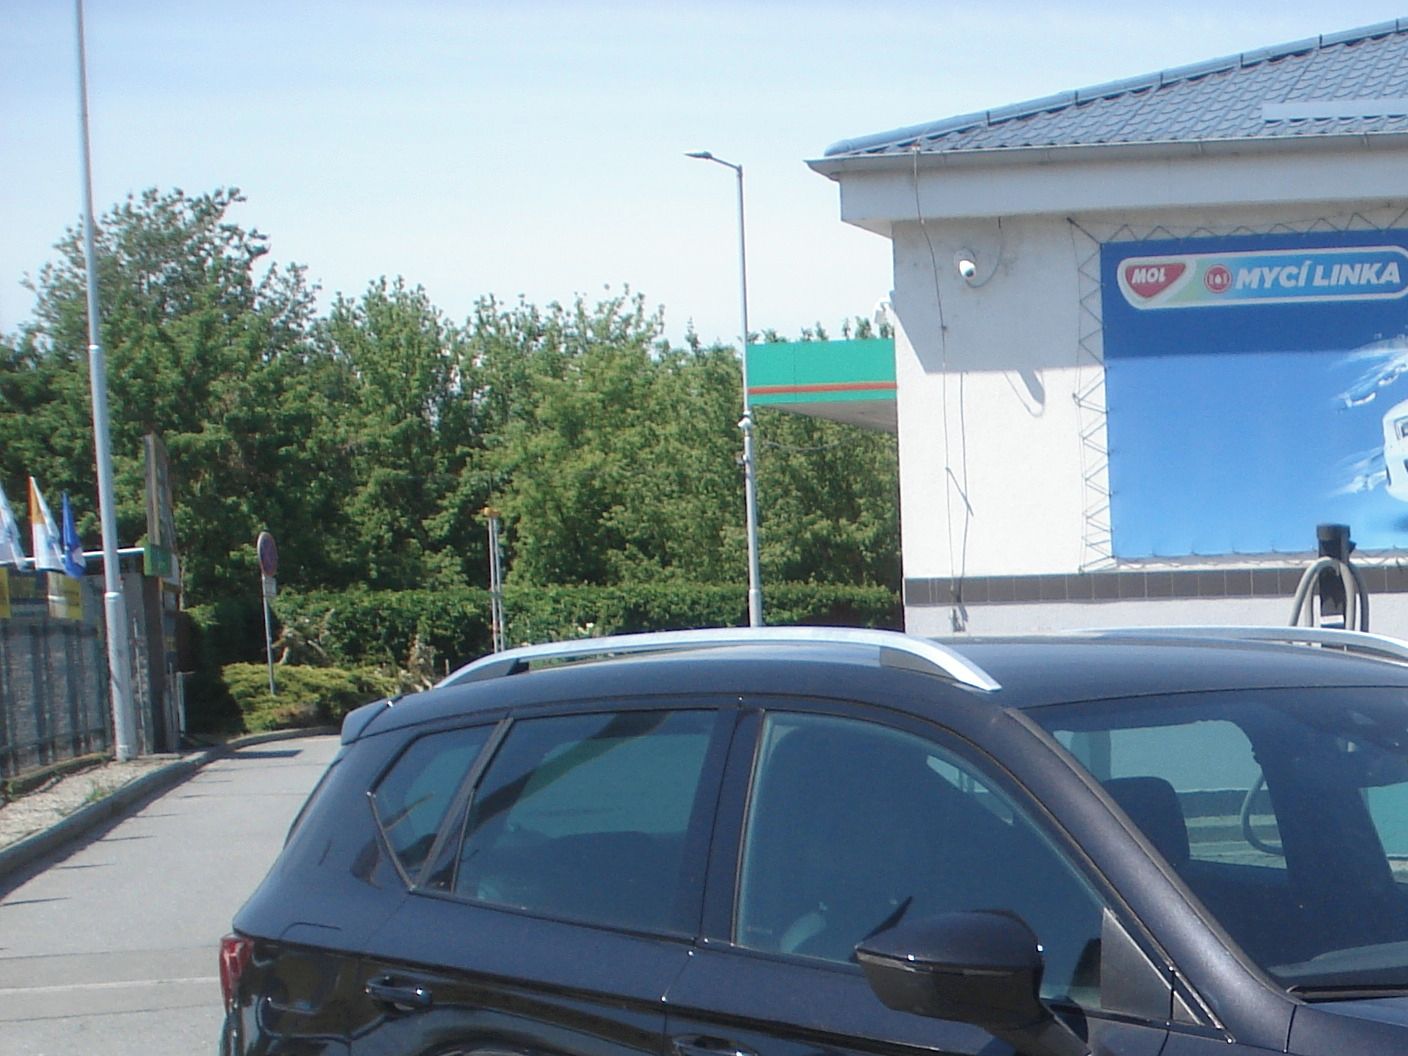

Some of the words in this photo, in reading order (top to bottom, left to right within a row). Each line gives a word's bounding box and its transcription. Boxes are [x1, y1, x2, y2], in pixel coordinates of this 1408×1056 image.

[1131, 267, 1167, 285] MOL
[1235, 260, 1314, 290] MYCÍ
[1313, 262, 1401, 288] LINKA
